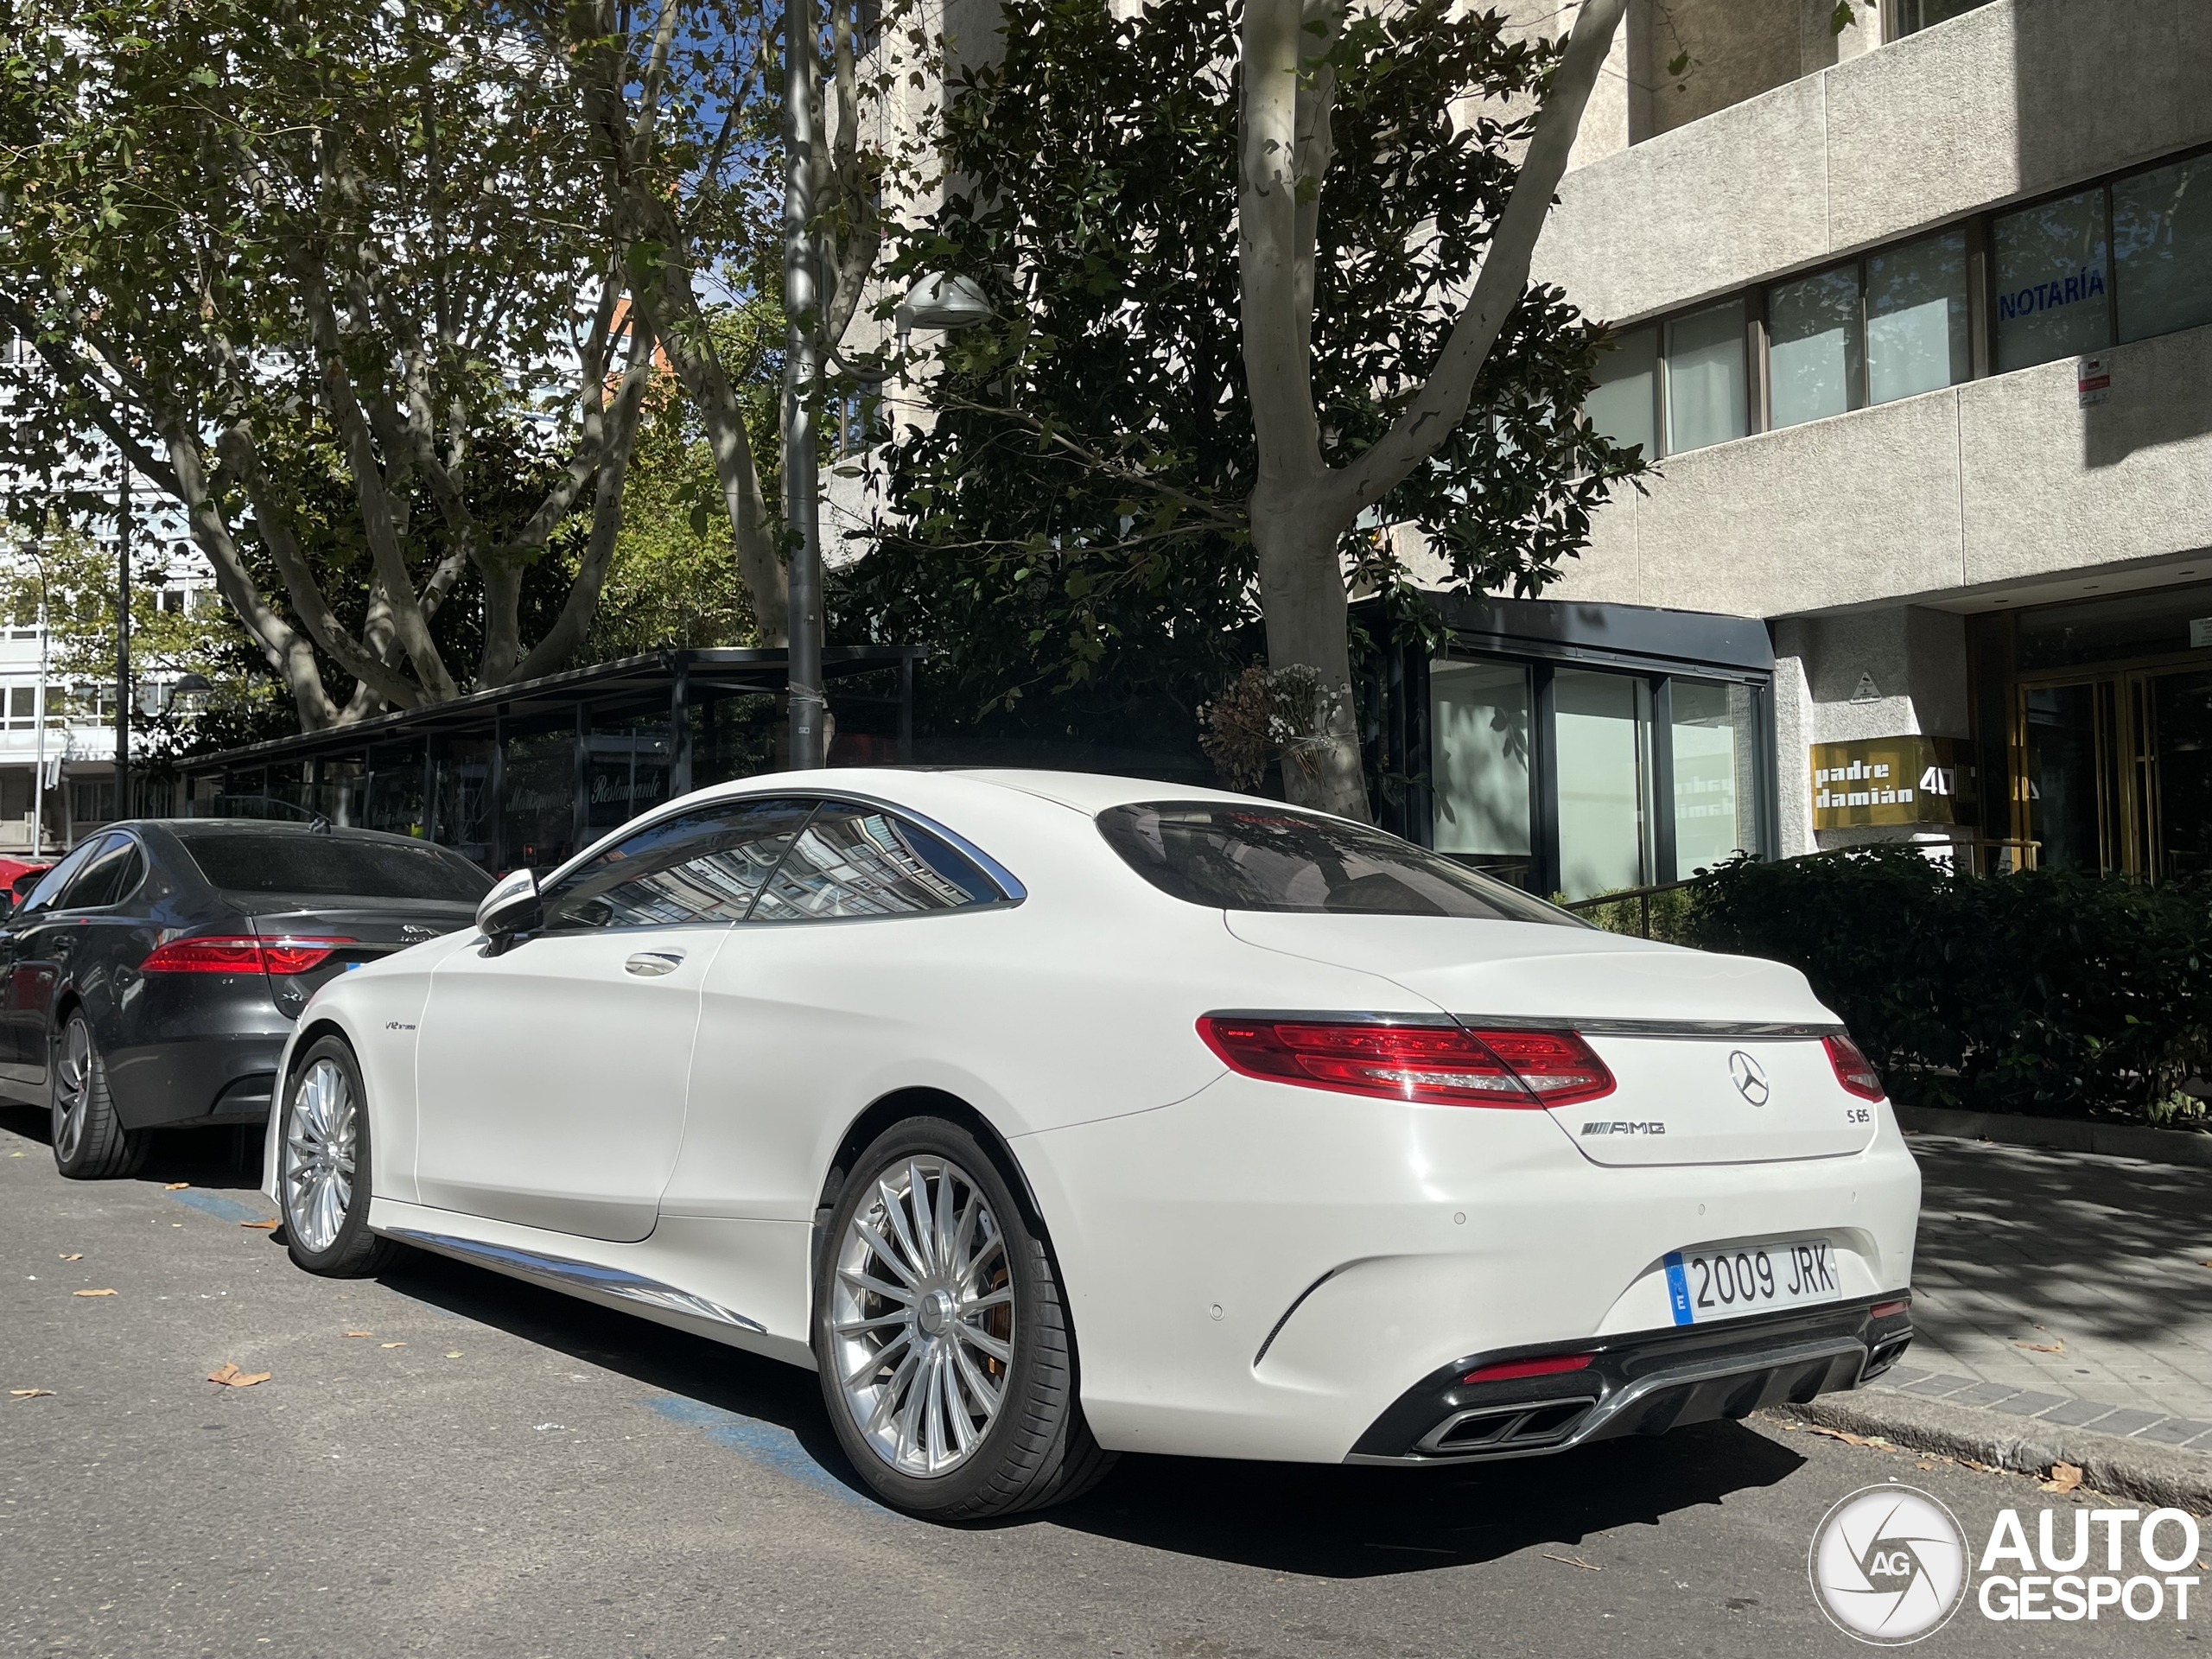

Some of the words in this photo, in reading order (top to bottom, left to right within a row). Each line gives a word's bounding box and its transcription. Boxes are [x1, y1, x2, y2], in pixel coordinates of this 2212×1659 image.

[1999, 266, 2105, 321] NOTARÍA
[1815, 760, 1890, 788] padre
[1920, 766, 1956, 796] 40
[1815, 785, 1914, 809] damián
[1608, 1122, 1666, 1135] AMG
[1847, 1109, 1856, 1123] S
[1856, 1109, 1870, 1122] 65
[1692, 1250, 1776, 1308] 2009
[1788, 1244, 1835, 1295] JRK
[1676, 1295, 1686, 1310] E
